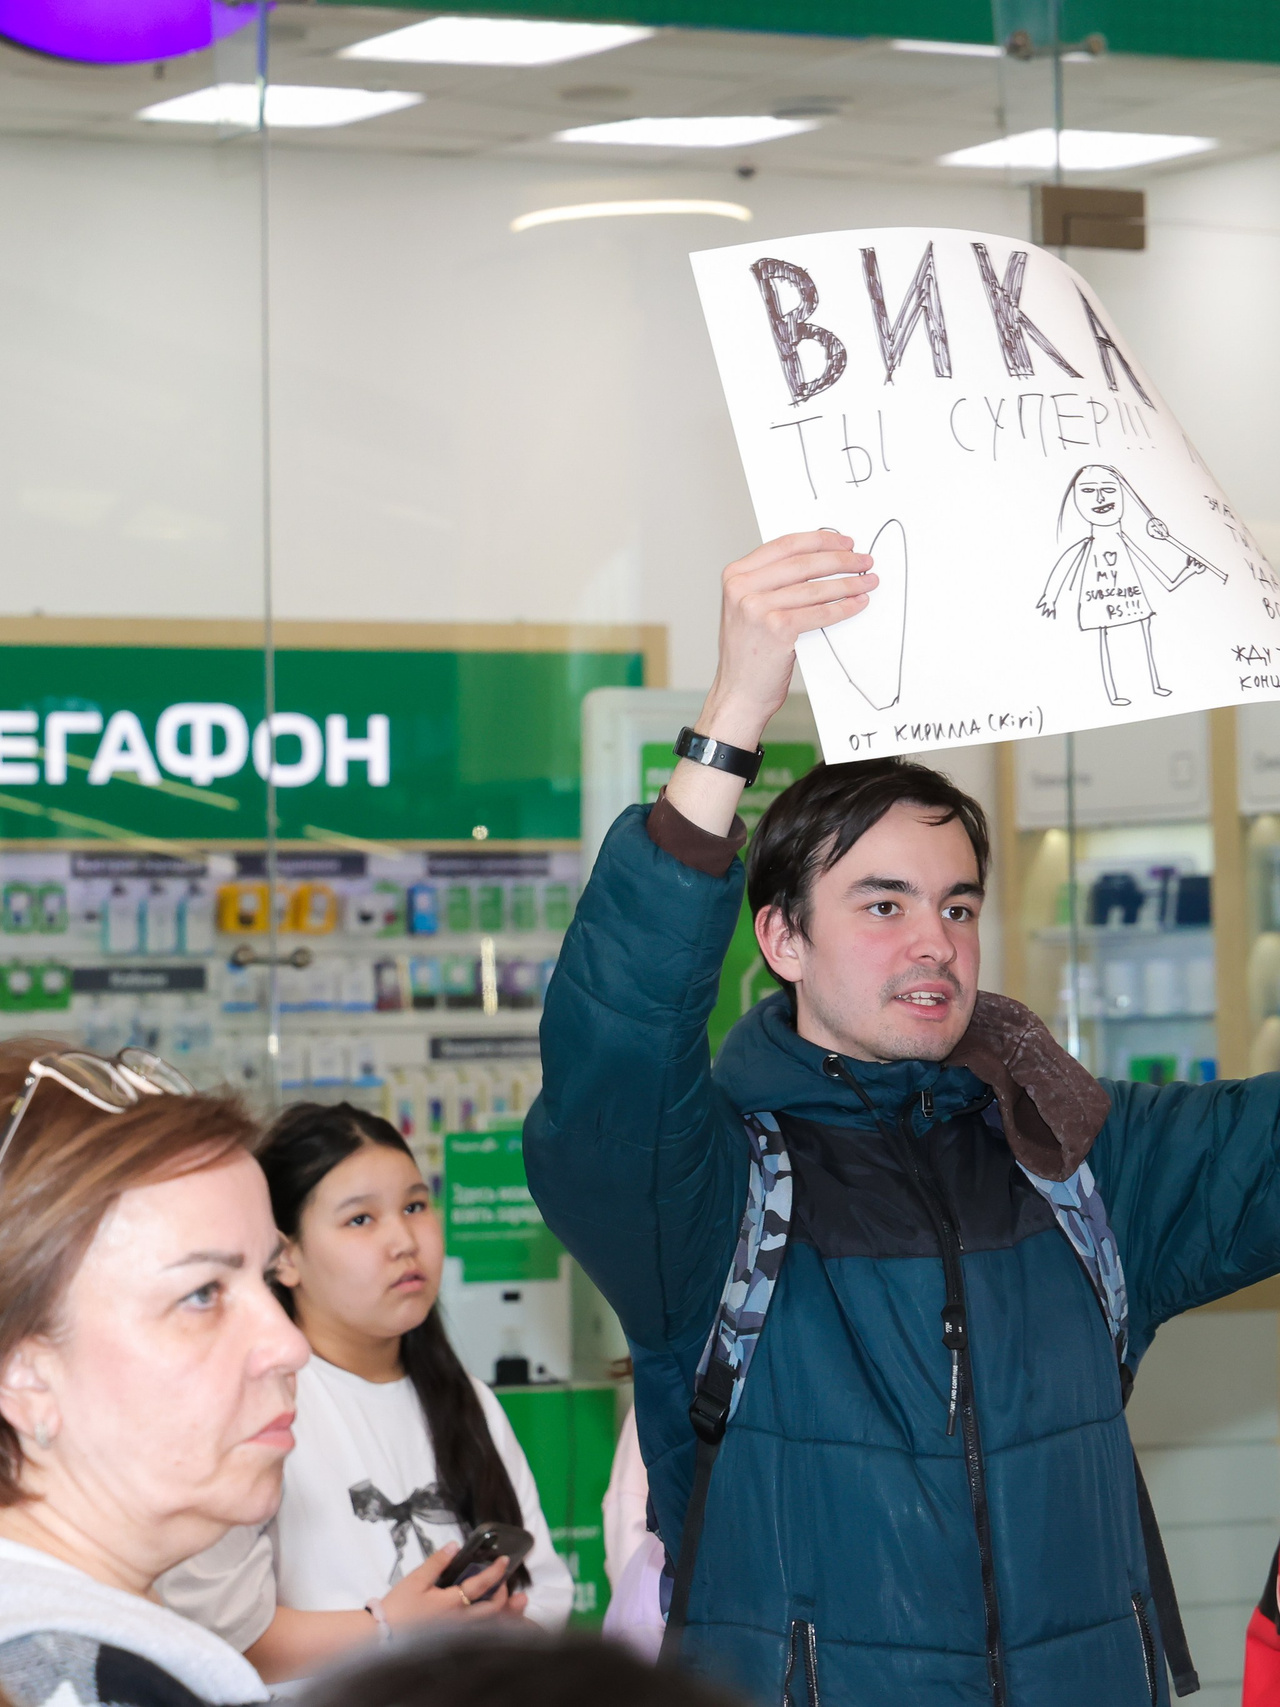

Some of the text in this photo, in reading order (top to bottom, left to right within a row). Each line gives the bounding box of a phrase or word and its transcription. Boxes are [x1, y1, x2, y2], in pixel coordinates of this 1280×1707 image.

[749, 240, 1157, 411] ВИКА
[949, 393, 1157, 461] СУПЕР!!!
[769, 409, 891, 501] ТЫ
[1096, 569, 1118, 587] MY
[1085, 585, 1142, 602] SUBSCRIBE
[1106, 599, 1143, 620] RS!!!
[1230, 644, 1272, 667] ЖДУ
[849, 731, 878, 750] ОТ
